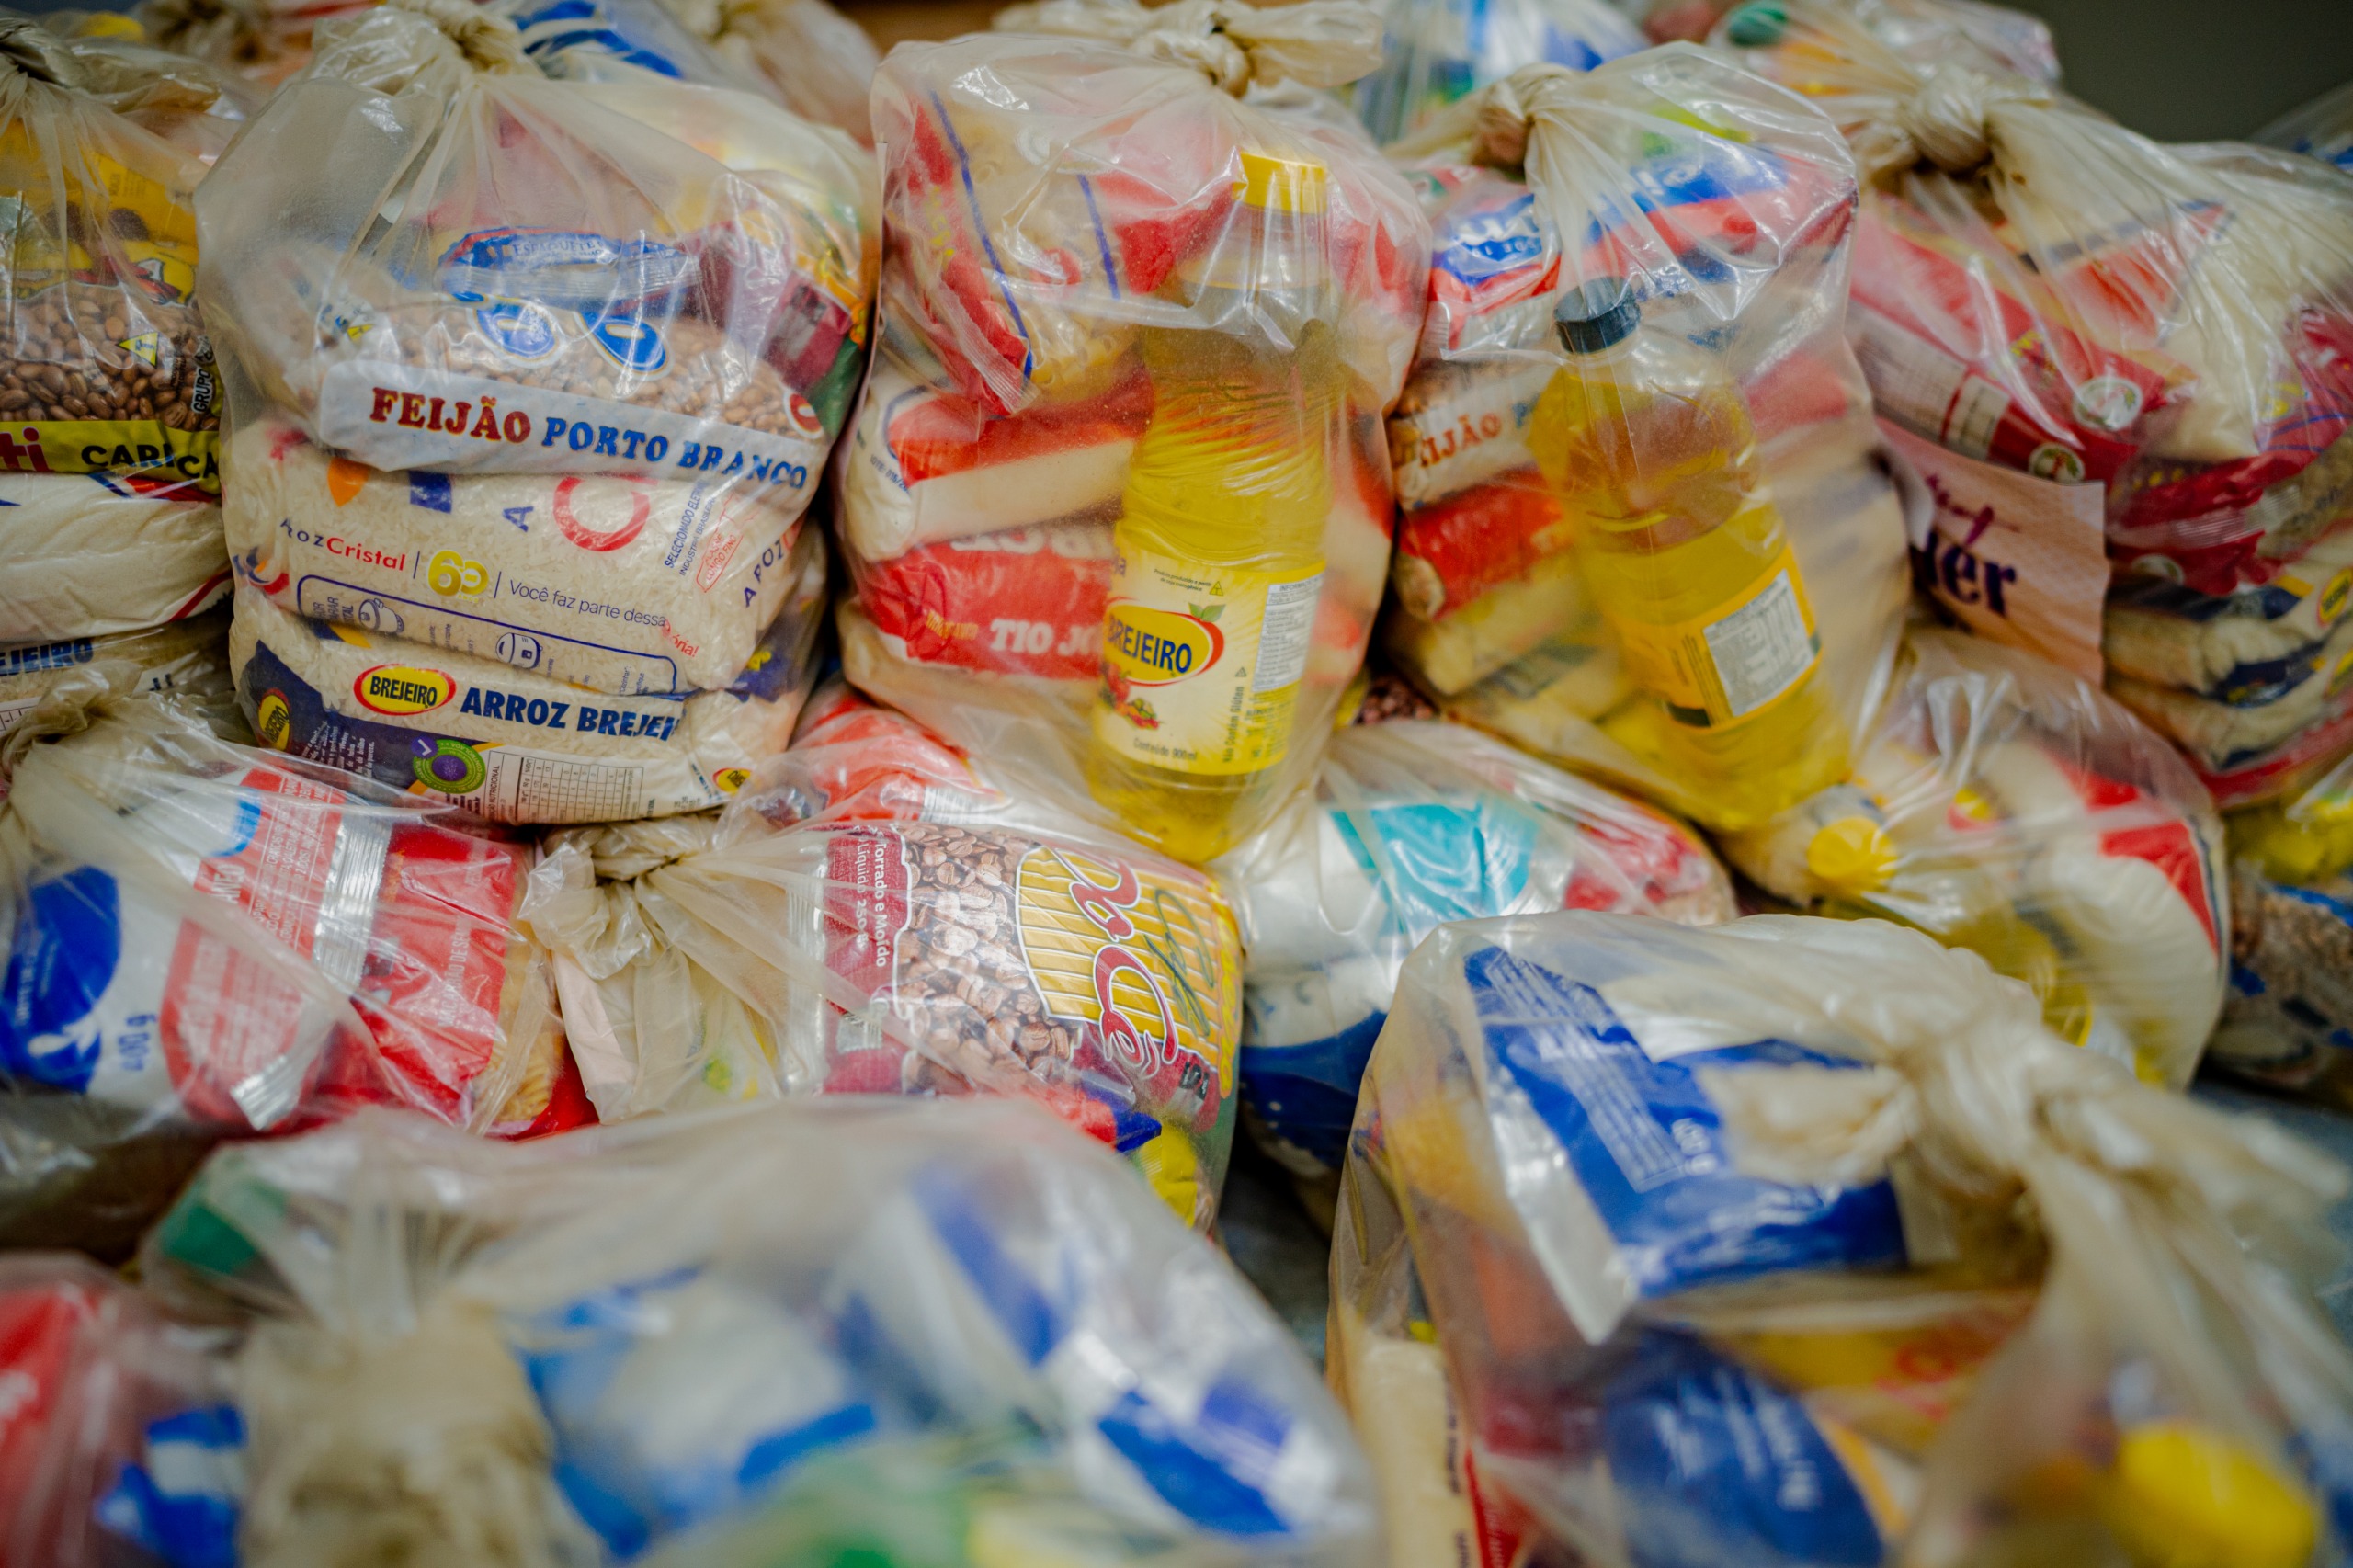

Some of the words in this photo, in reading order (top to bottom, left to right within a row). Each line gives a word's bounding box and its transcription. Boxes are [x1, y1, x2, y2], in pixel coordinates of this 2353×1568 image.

[193, 369, 211, 413] GRUPO
[369, 387, 531, 444] FEIJÃO
[541, 416, 669, 463] PORTO
[676, 440, 808, 490] BRANCO
[664, 509, 695, 569] SELECIONADO
[510, 579, 550, 602] Você
[552, 590, 576, 609] faz
[578, 599, 621, 619] parte
[623, 608, 667, 627] dessa
[989, 617, 1055, 654] TIO
[369, 675, 438, 707] BREJEIRO
[460, 687, 570, 729] ARROZ
[1230, 685, 1245, 715] Glúten
[489, 765, 501, 803] NUTRICIONAL
[855, 842, 870, 893] Líquido
[875, 842, 887, 897] Torrado
[875, 902, 884, 912] e
[875, 914, 889, 967] Moído
